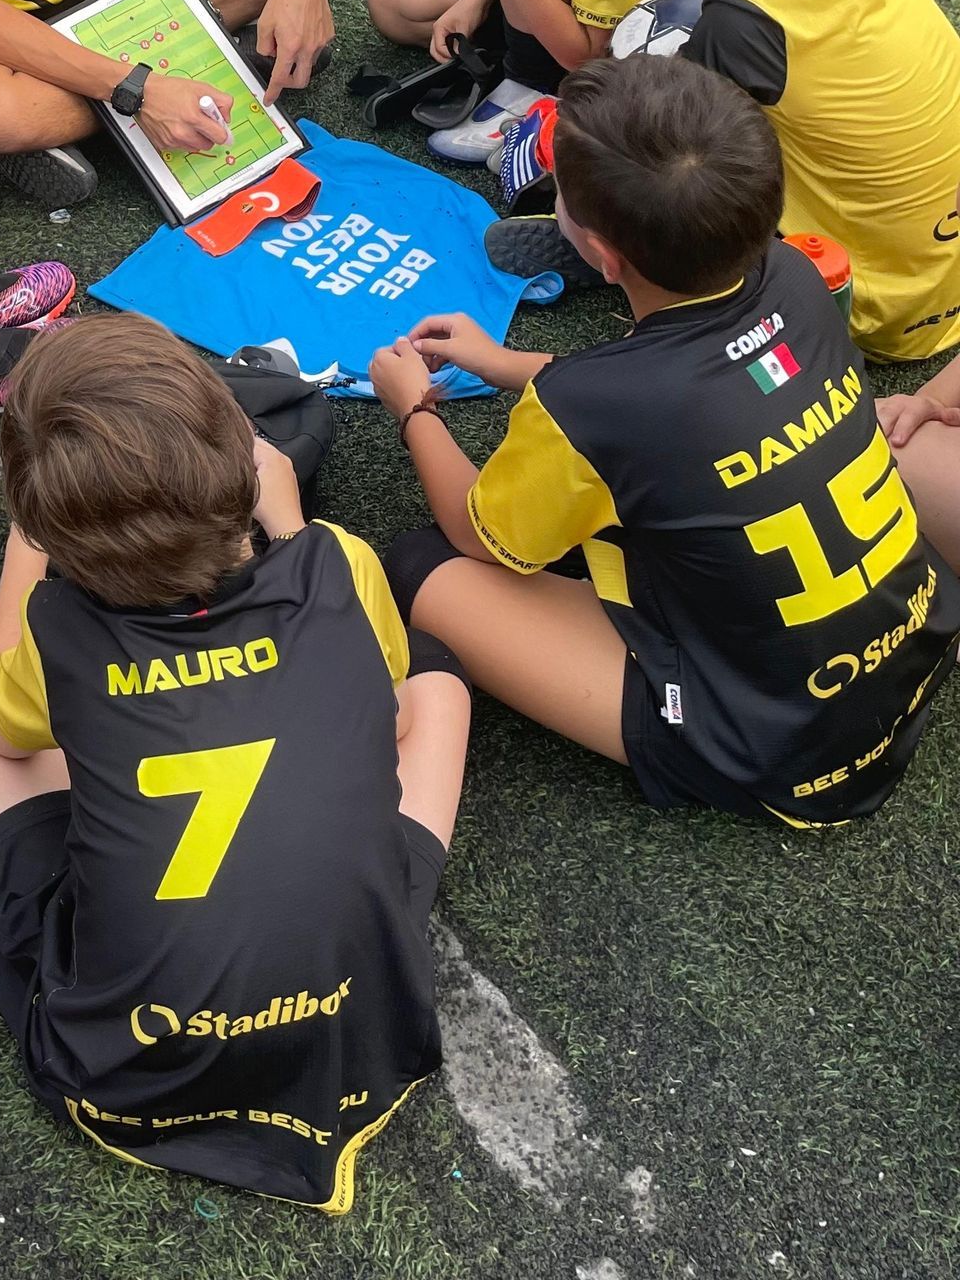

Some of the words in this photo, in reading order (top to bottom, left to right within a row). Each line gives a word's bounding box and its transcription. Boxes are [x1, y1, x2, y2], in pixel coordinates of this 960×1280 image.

[261, 213, 334, 259] YOU
[291, 213, 375, 279] BEST
[315, 228, 411, 296] YOUR
[368, 248, 437, 300] BEE
[713, 365, 863, 489] DAMIÁN
[481, 526, 498, 549] BEE
[743, 422, 918, 627] 15
[107, 636, 279, 696] MAURO
[793, 766, 849, 799] BEE
[137, 737, 277, 901] 7
[80, 1098, 142, 1127] BEE
[151, 1108, 239, 1129] YOUR
[248, 1109, 332, 1145] BEST
